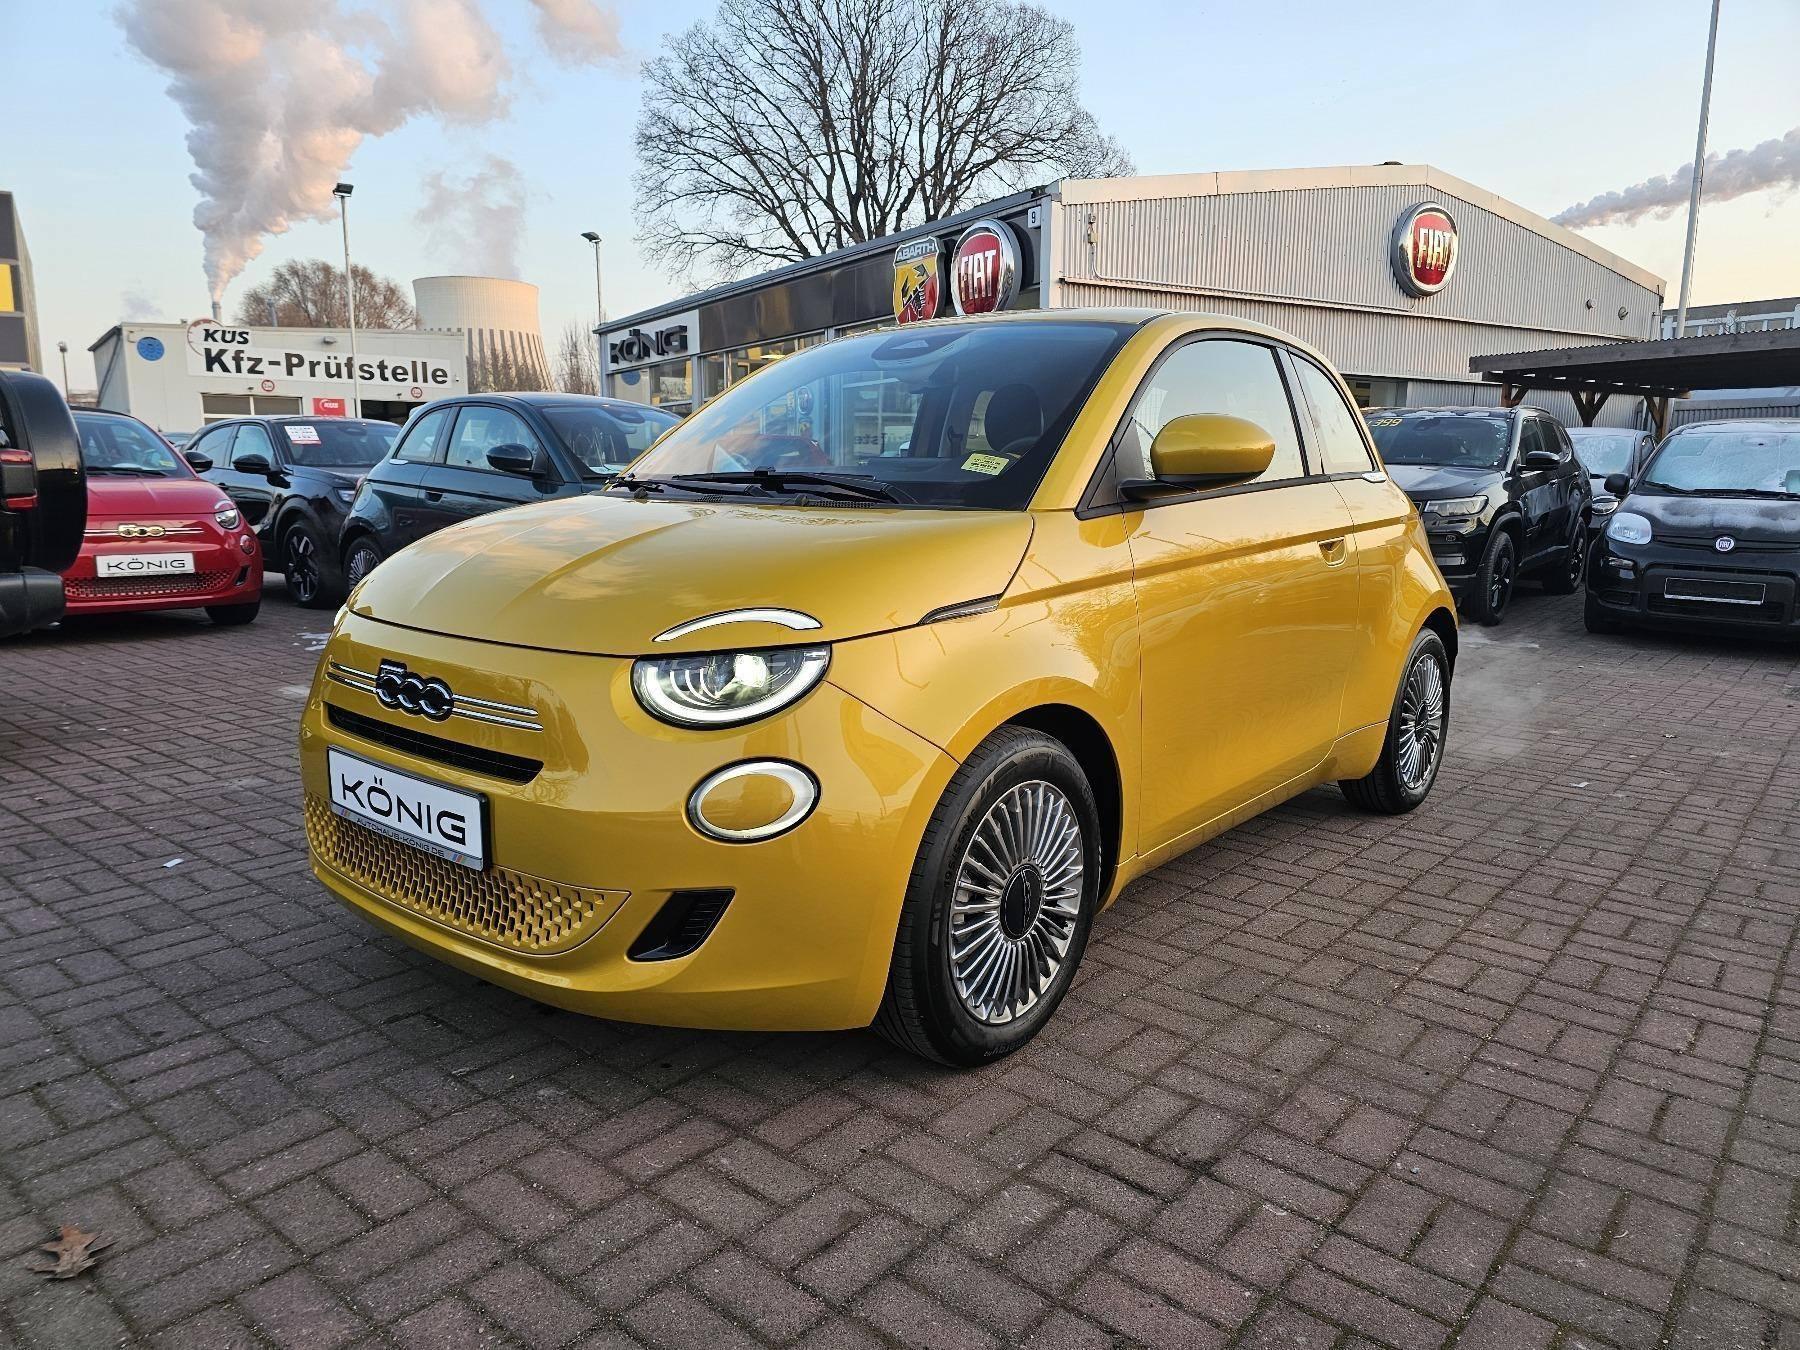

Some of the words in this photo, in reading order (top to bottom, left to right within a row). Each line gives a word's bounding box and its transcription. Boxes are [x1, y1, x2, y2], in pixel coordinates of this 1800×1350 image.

[1031, 211, 1036, 224] 9
[896, 243, 935, 261] ABARTH
[1417, 228, 1453, 271] FIAT
[961, 249, 997, 302] FIAT
[203, 329, 249, 344] KÜS
[610, 325, 688, 364] KÖNIG
[204, 347, 448, 385] Kfz-Prüfstelle
[118, 524, 165, 538] 500
[107, 558, 186, 571] KÖNIG
[376, 659, 453, 721] 500
[341, 773, 466, 846] KÖNIG
